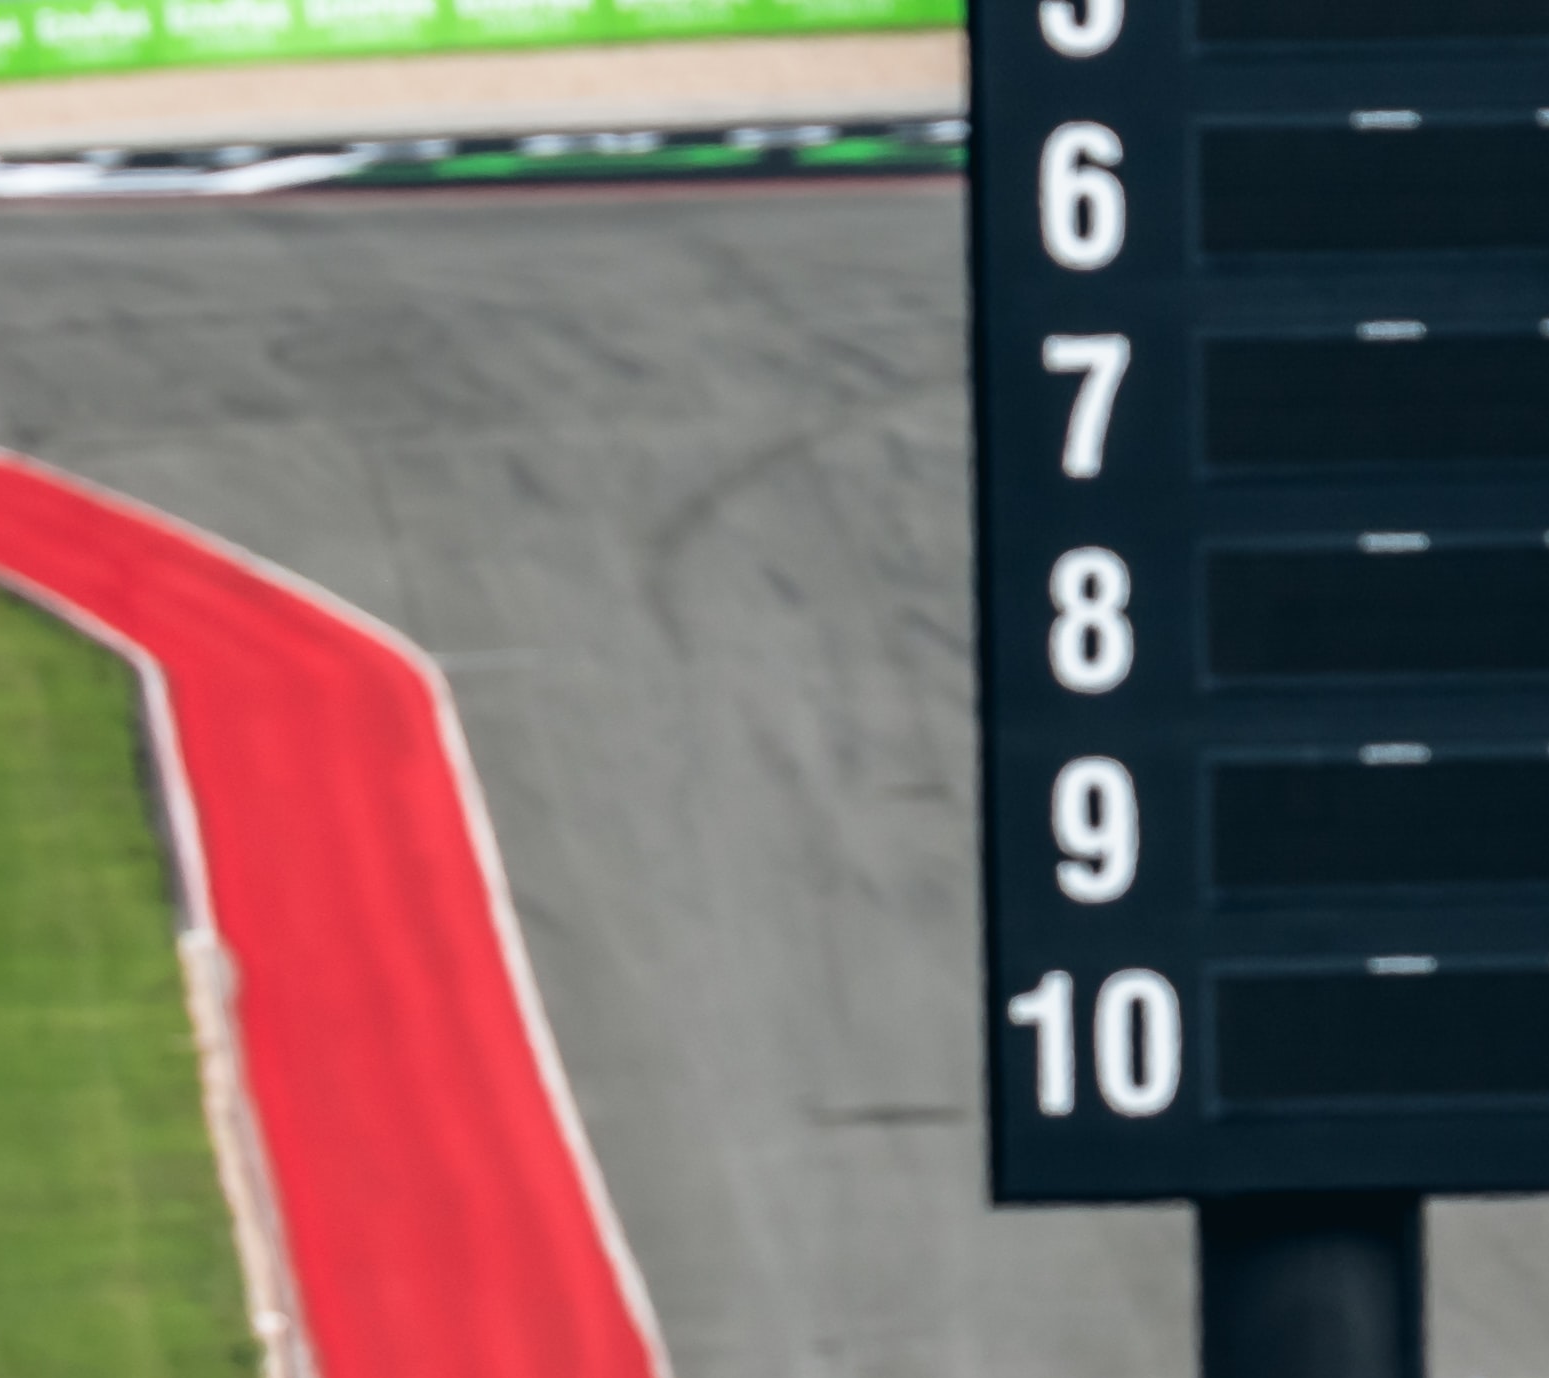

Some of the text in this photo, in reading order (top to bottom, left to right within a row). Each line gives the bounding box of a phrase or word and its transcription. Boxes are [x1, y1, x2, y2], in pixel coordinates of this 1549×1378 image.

[1039, 121, 1126, 270] 6
[1042, 333, 1131, 478] 7
[1049, 546, 1134, 694] 8
[1052, 755, 1140, 903] 9
[1008, 968, 1182, 1117] 10
